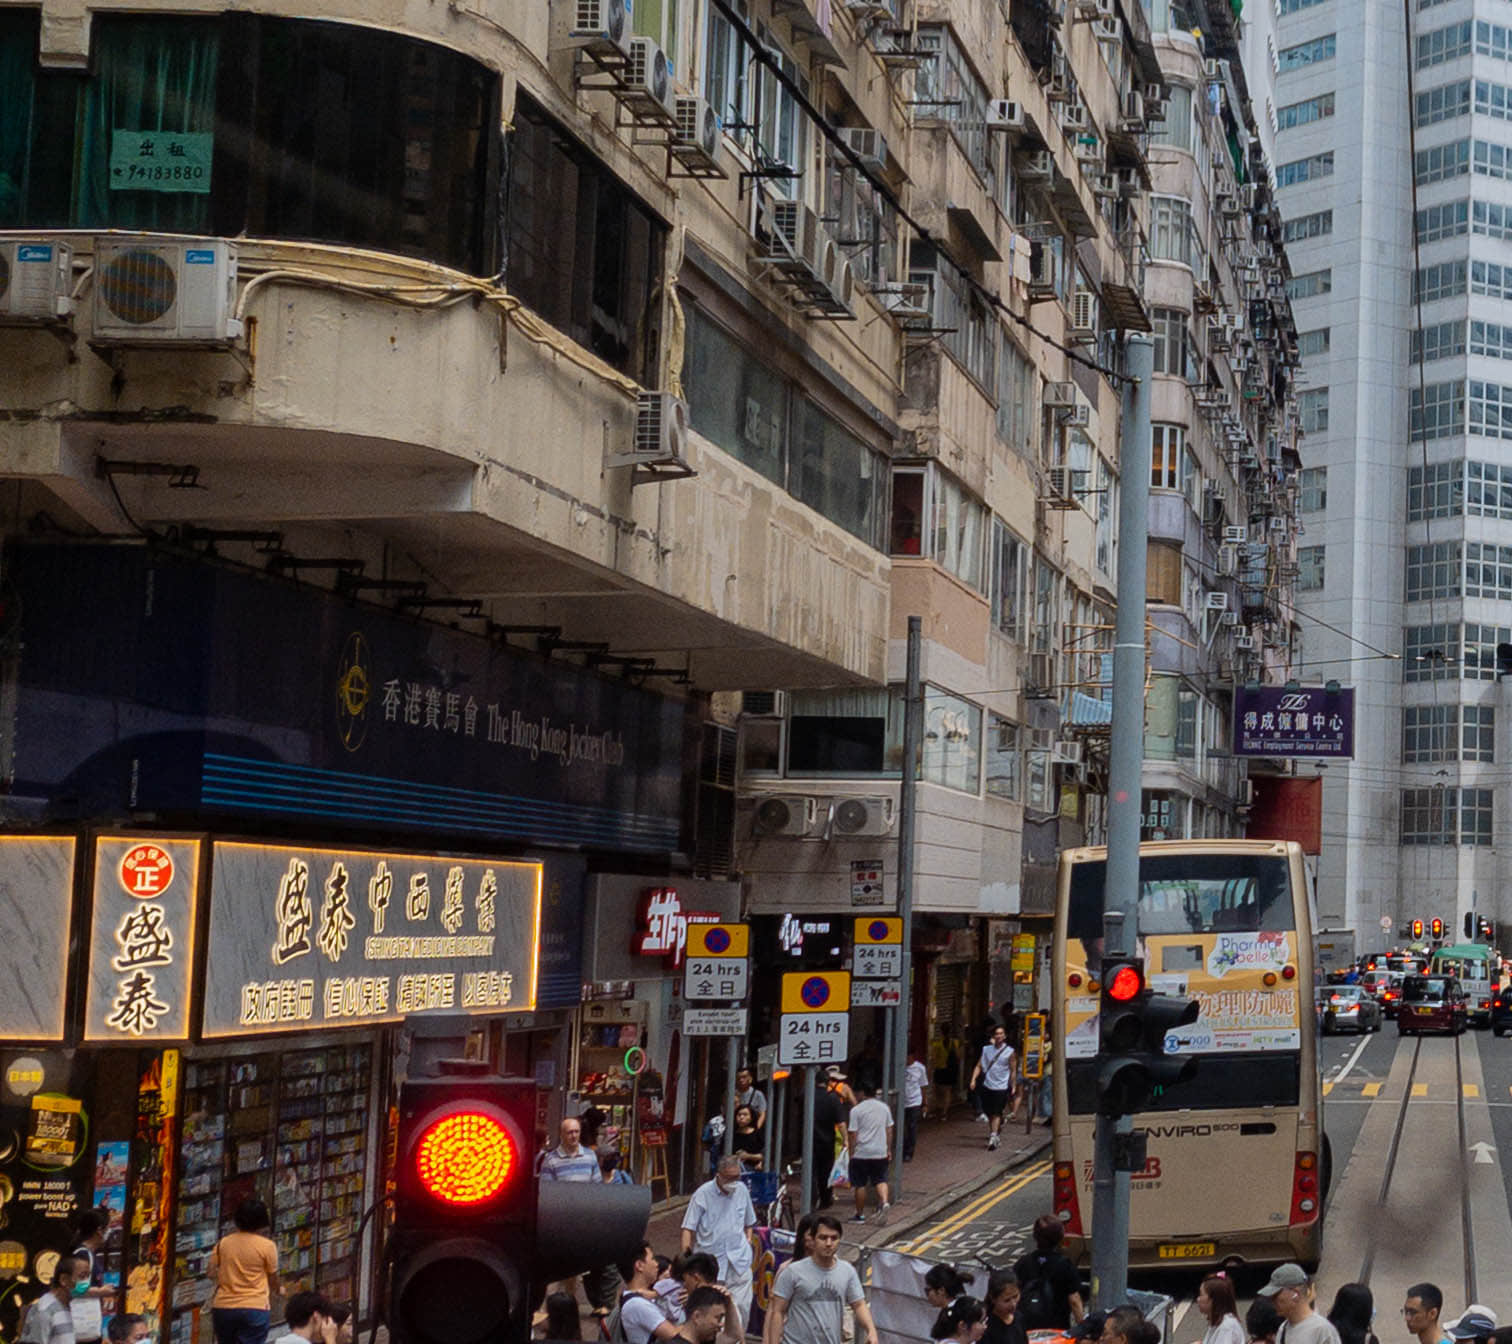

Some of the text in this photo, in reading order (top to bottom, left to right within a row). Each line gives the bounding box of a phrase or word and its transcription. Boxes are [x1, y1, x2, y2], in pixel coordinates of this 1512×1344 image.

[139, 138, 186, 157] 出租
[381, 678, 480, 737] 香港賽馬會
[486, 703, 510, 745] The
[510, 709, 540, 761] Hong
[133, 866, 160, 892] 正
[858, 947, 897, 958] 24 hrs
[1221, 937, 1278, 953] Pharma
[110, 904, 171, 1035] 盛泰
[692, 963, 741, 976] 24 hrs
[863, 961, 892, 974] 全日
[697, 980, 735, 996] 全日
[788, 1020, 841, 1035] 24 hrs
[793, 1040, 834, 1060] 全日
